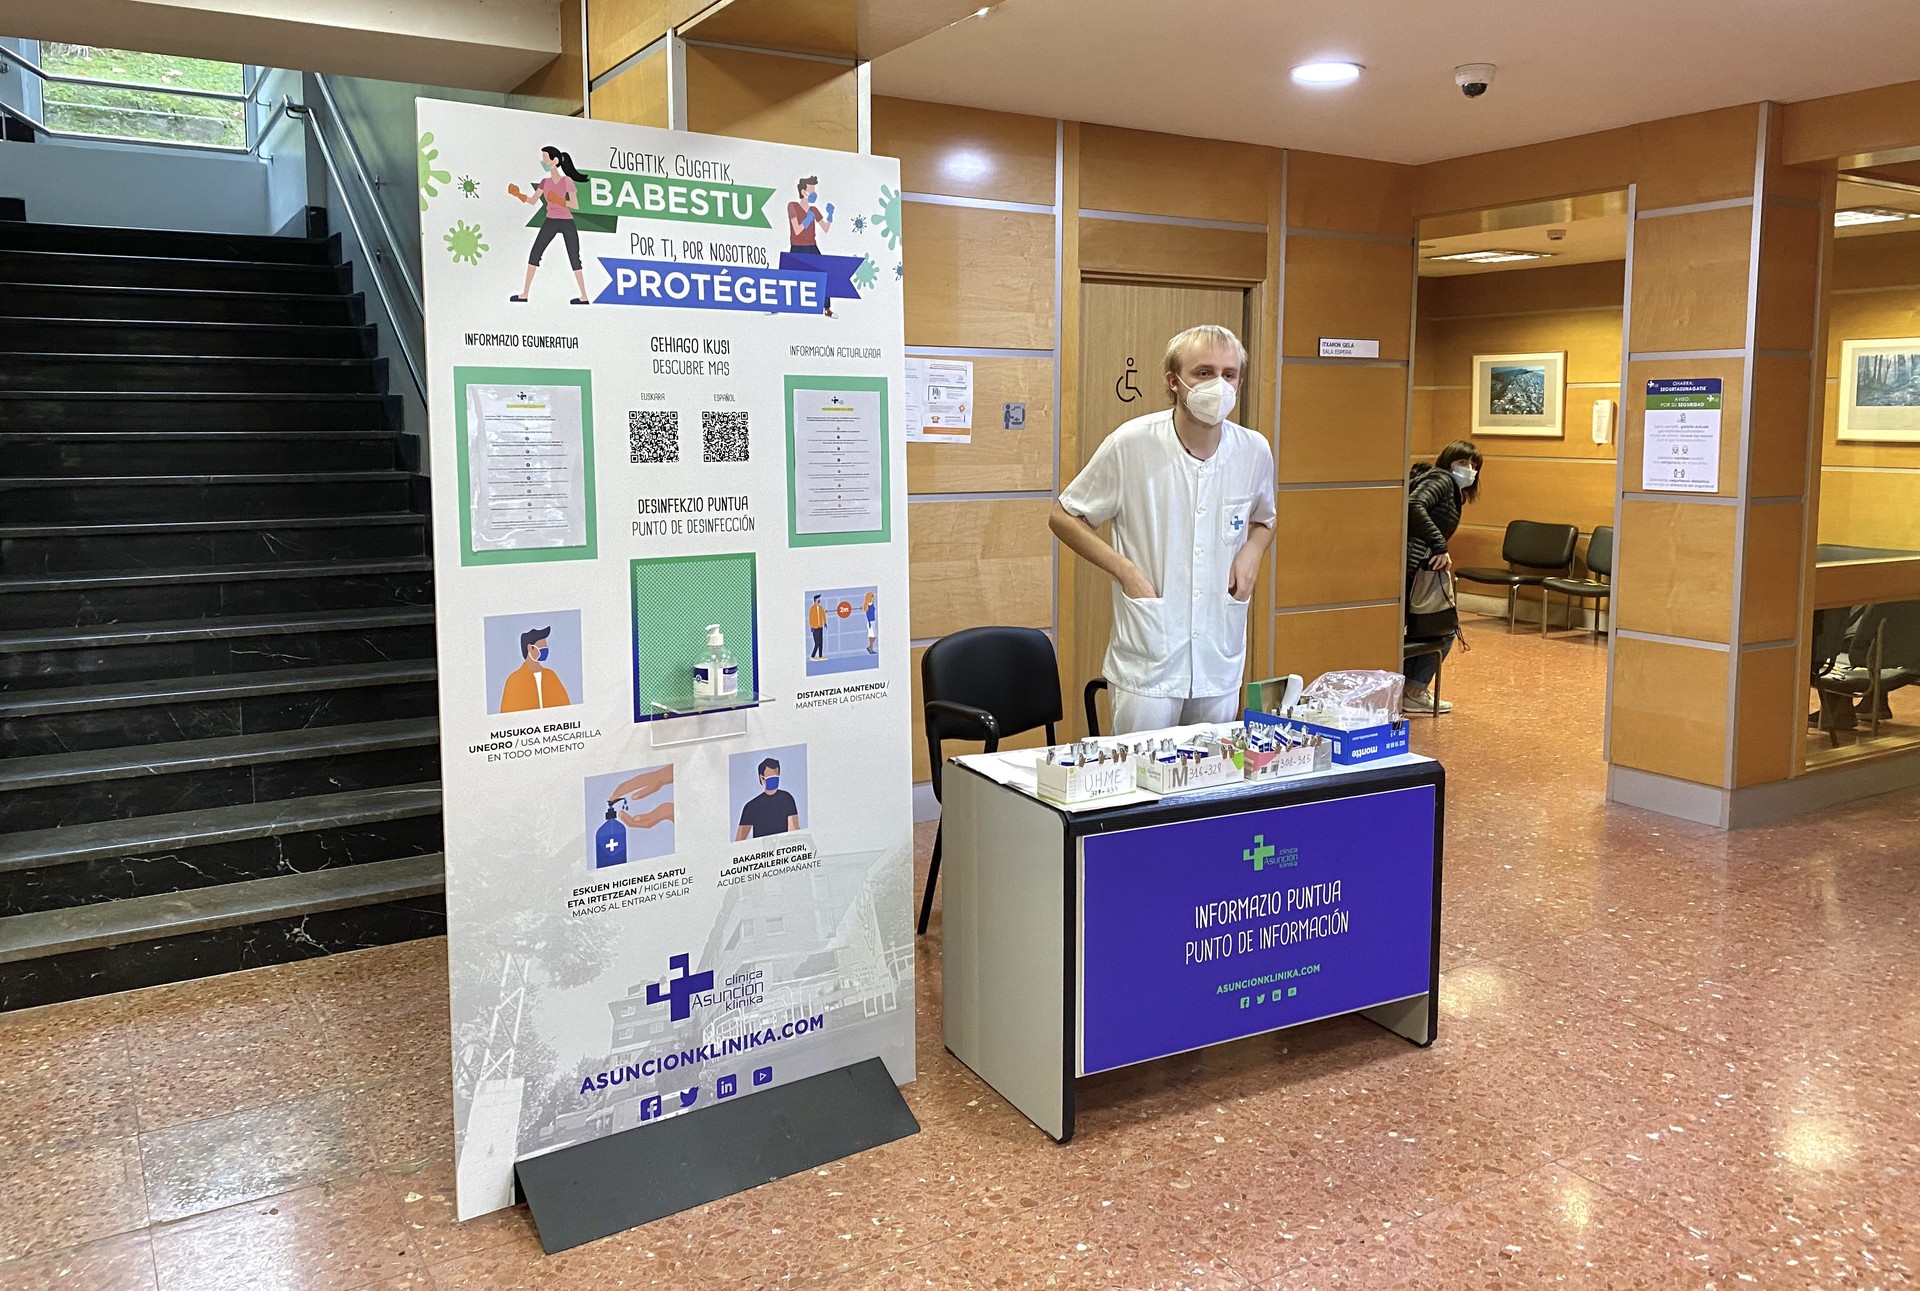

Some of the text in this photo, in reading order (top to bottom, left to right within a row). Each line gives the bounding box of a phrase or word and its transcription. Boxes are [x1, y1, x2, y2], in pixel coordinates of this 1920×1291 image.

[590, 177, 753, 221] BABESTU
[630, 232, 770, 269] POR TI, POR NOSOTROS,
[616, 267, 818, 308] PROTÉGETE
[465, 333, 579, 349] INFORMAZIO EGUNERATUA
[650, 336, 730, 355] GEHIAGO IKUSI
[789, 344, 881, 359] INFORMACIÓN ACTUALIZADA
[652, 359, 730, 376] DESCUBRE MAS
[640, 392, 665, 401] EUSKARA
[713, 392, 735, 402] ESPAÑOL
[637, 495, 748, 514] DESINFEKZIO PUNTUA
[632, 516, 755, 537] PUNTO DE DESINFECCIÓN
[795, 691, 888, 710] MANTENER LA DISTANCIA
[796, 687, 842, 700] DISTANTZIA
[843, 682, 886, 693] MANTENDU
[490, 721, 581, 740] MUSUKOA ERABILI
[468, 740, 513, 754] UNEORO
[520, 736, 541, 747] USA
[542, 729, 602, 744] MASCARILLA
[1352, 746, 1378, 758] montte
[487, 742, 585, 763] EN TODO MOMENTO
[1280, 754, 1311, 769] 301-315
[720, 857, 789, 878] LAGUNTZAILERIK
[791, 852, 812, 864] GABE
[732, 844, 807, 865] BAKARRIK ETORRI,
[572, 867, 686, 897] ESKUEN HIGIENEA SARTU
[716, 859, 822, 888] ACUDE SIN ACOMPAÑANTE
[567, 897, 585, 909] ETA
[587, 888, 637, 906] IRTETZEAN
[644, 880, 680, 894] HIGIENE
[681, 876, 694, 886] DE
[572, 886, 690, 918] MANOS AL ENTRAR Y SALIR
[1195, 880, 1341, 929] INFORMAZIO PUNTUA
[1185, 908, 1349, 965] PUNTO DE INFORMACIÓN
[1216, 963, 1320, 995] ASUNCIONKLINIKA.COM
[691, 980, 764, 1010] Asunción
[725, 995, 763, 1012] klinika
[579, 1014, 824, 1094] ASUNCIONKLINIKA.COM
